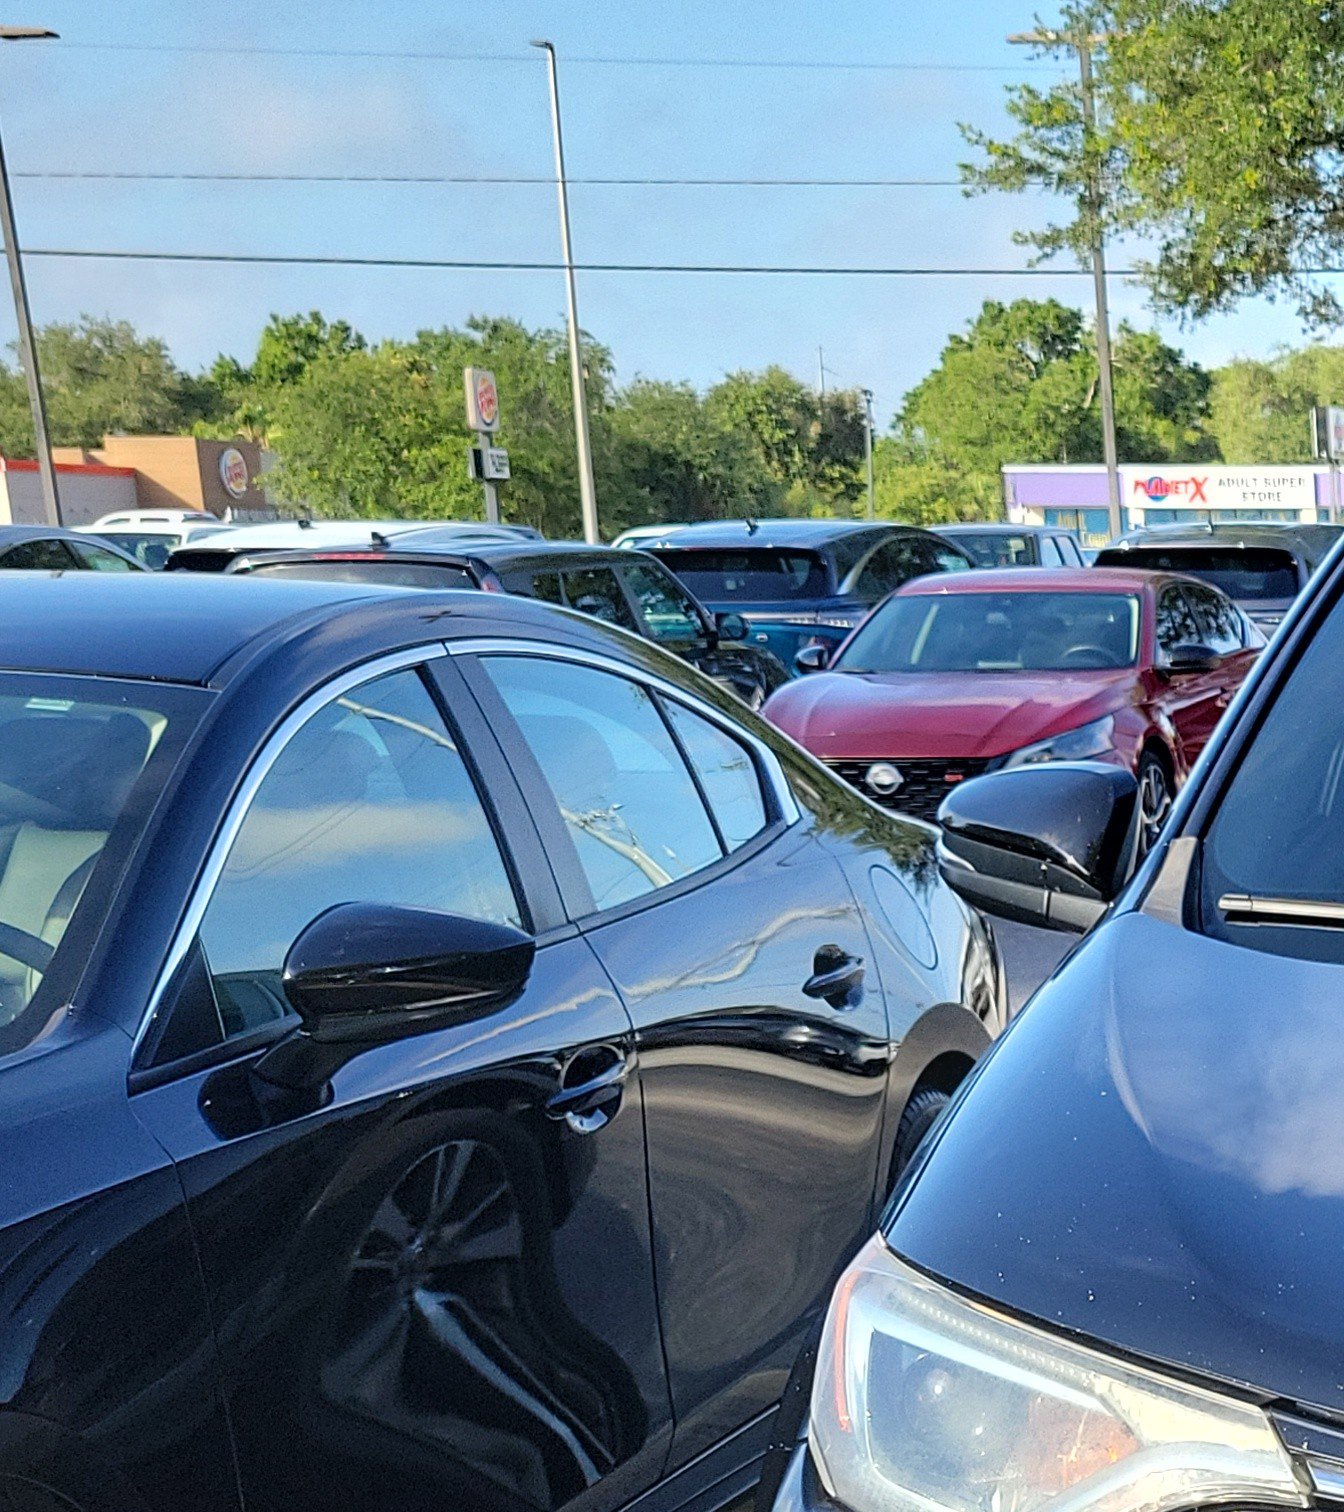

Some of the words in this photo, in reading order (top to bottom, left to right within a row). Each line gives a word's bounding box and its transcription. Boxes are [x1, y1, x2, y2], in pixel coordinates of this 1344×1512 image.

[1217, 477, 1258, 488] ADULT
[1264, 478, 1305, 488] SUPER
[1241, 491, 1283, 503] STORE
